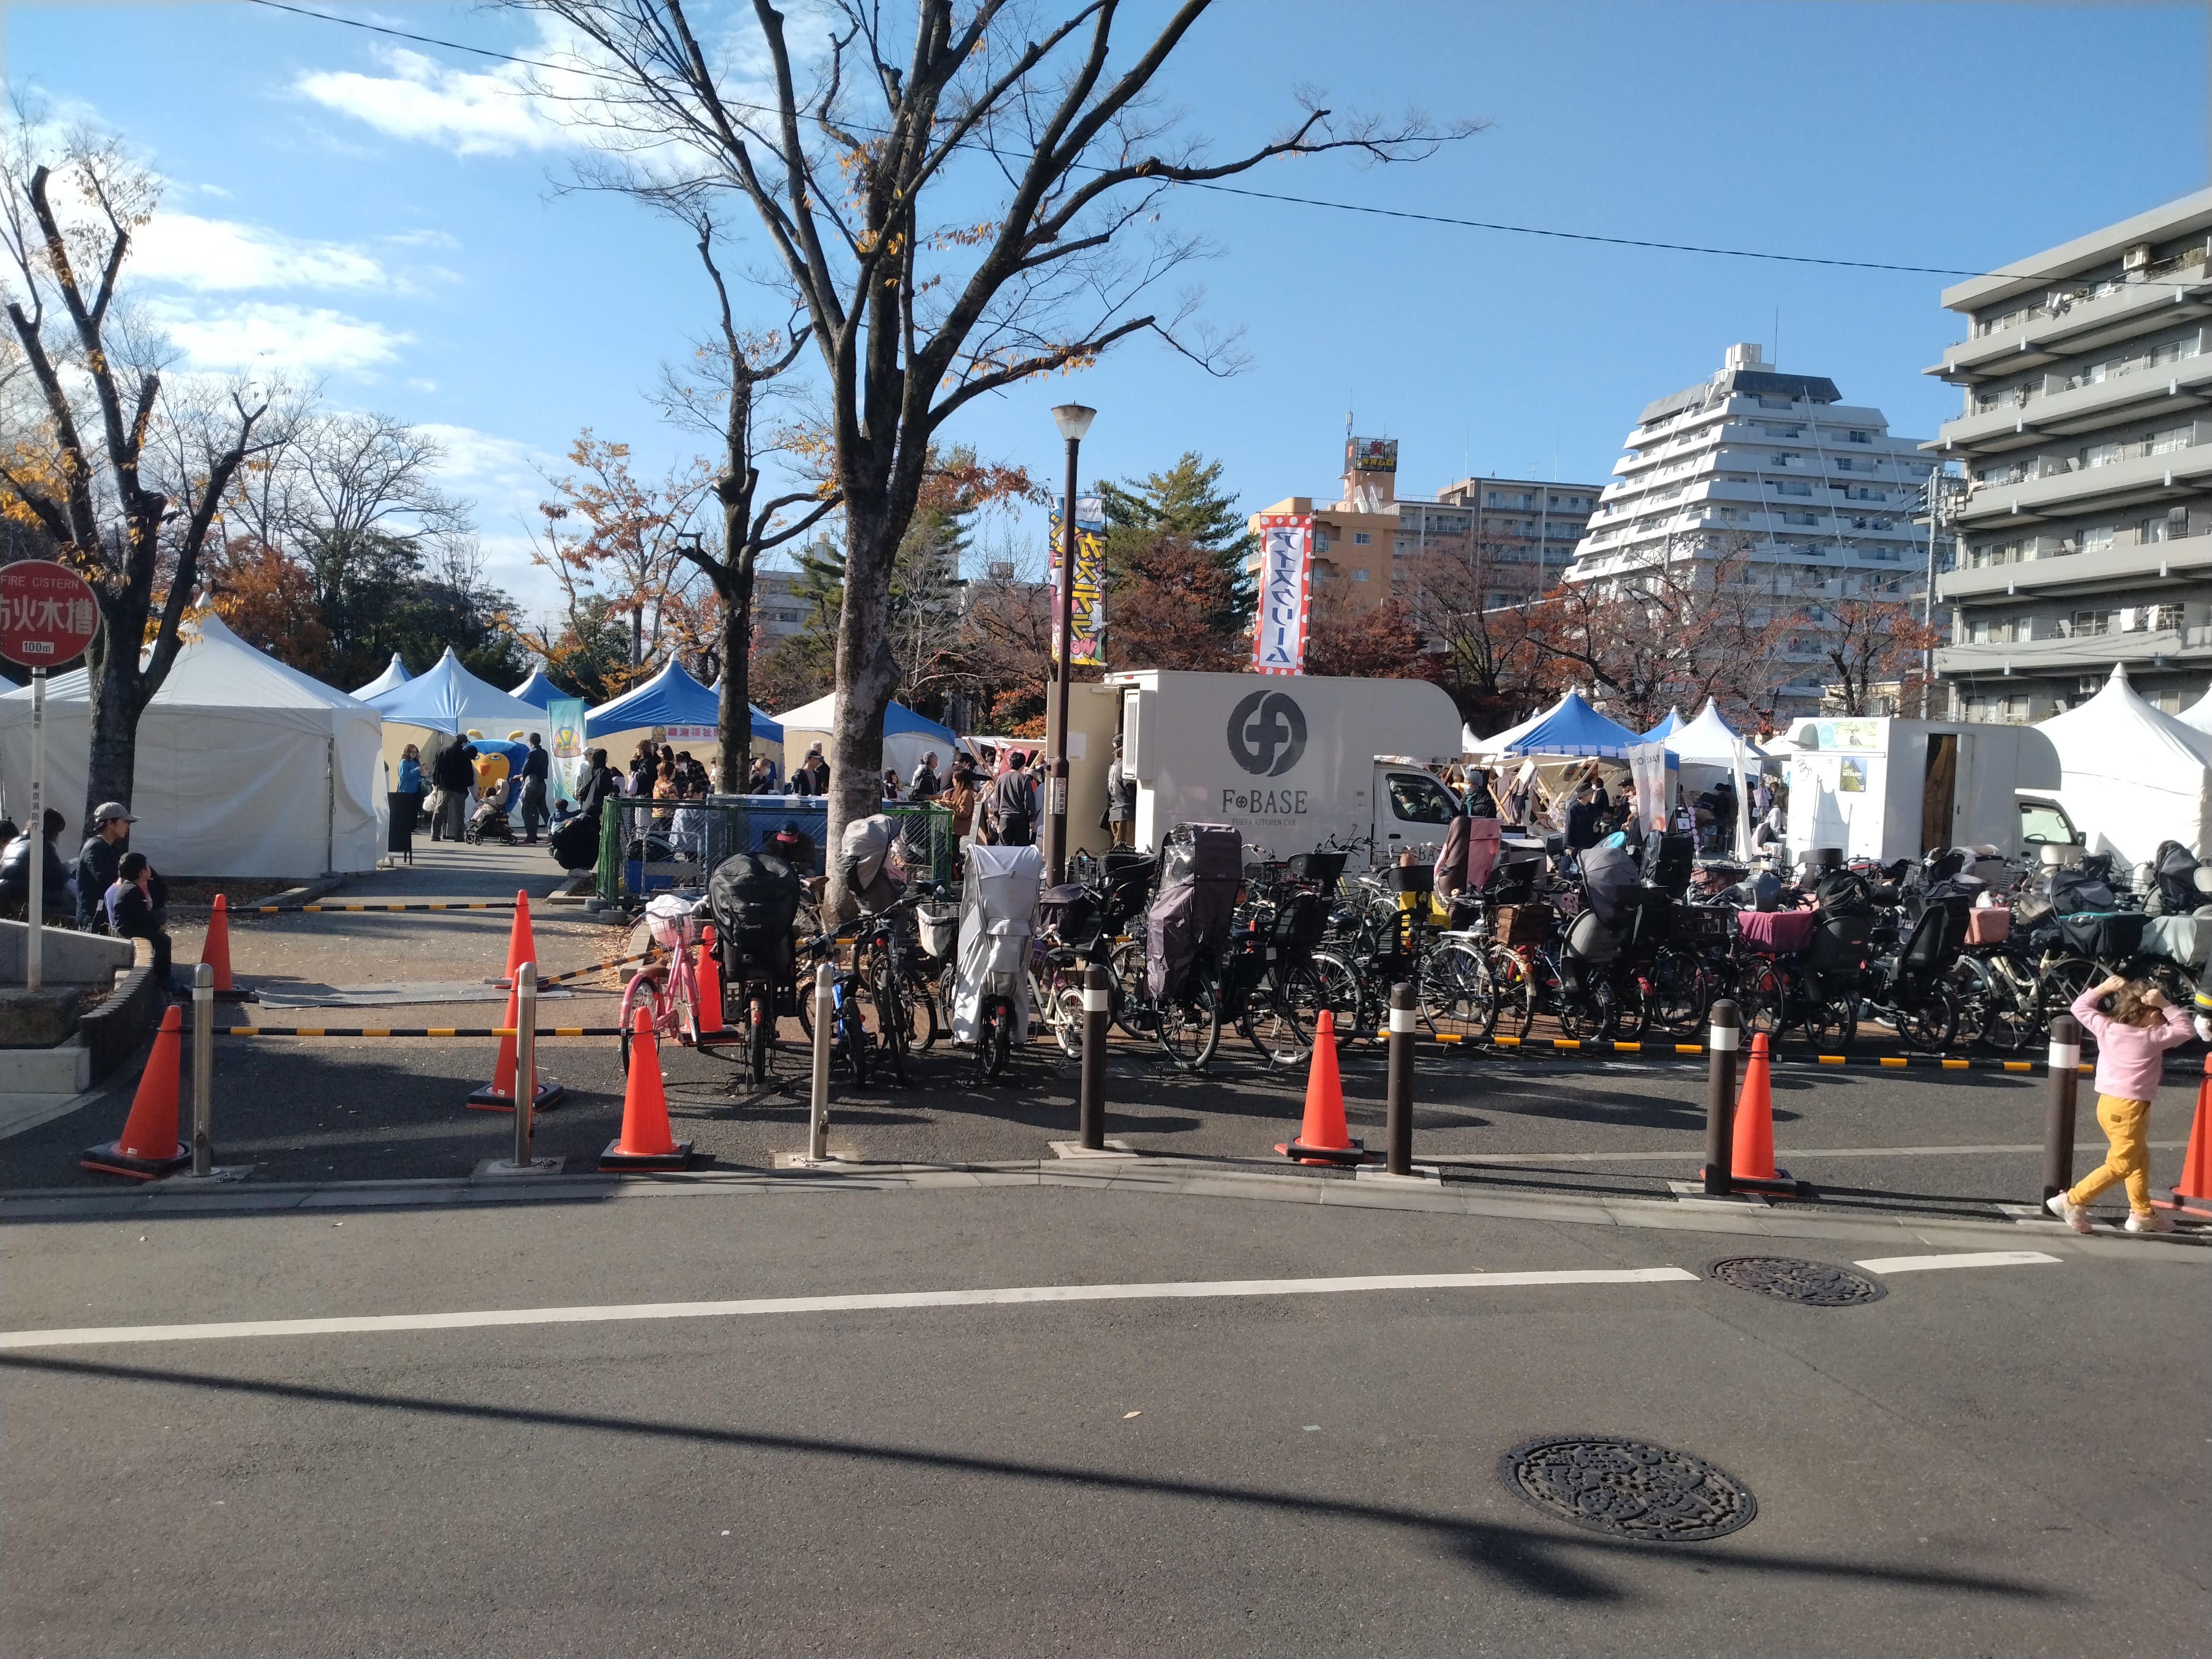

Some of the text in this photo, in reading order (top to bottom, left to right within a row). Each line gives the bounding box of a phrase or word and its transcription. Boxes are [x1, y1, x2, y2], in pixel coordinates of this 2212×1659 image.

[1, 575, 79, 590] FIRE CISTERN
[32, 782, 40, 831] 東京消防庁
